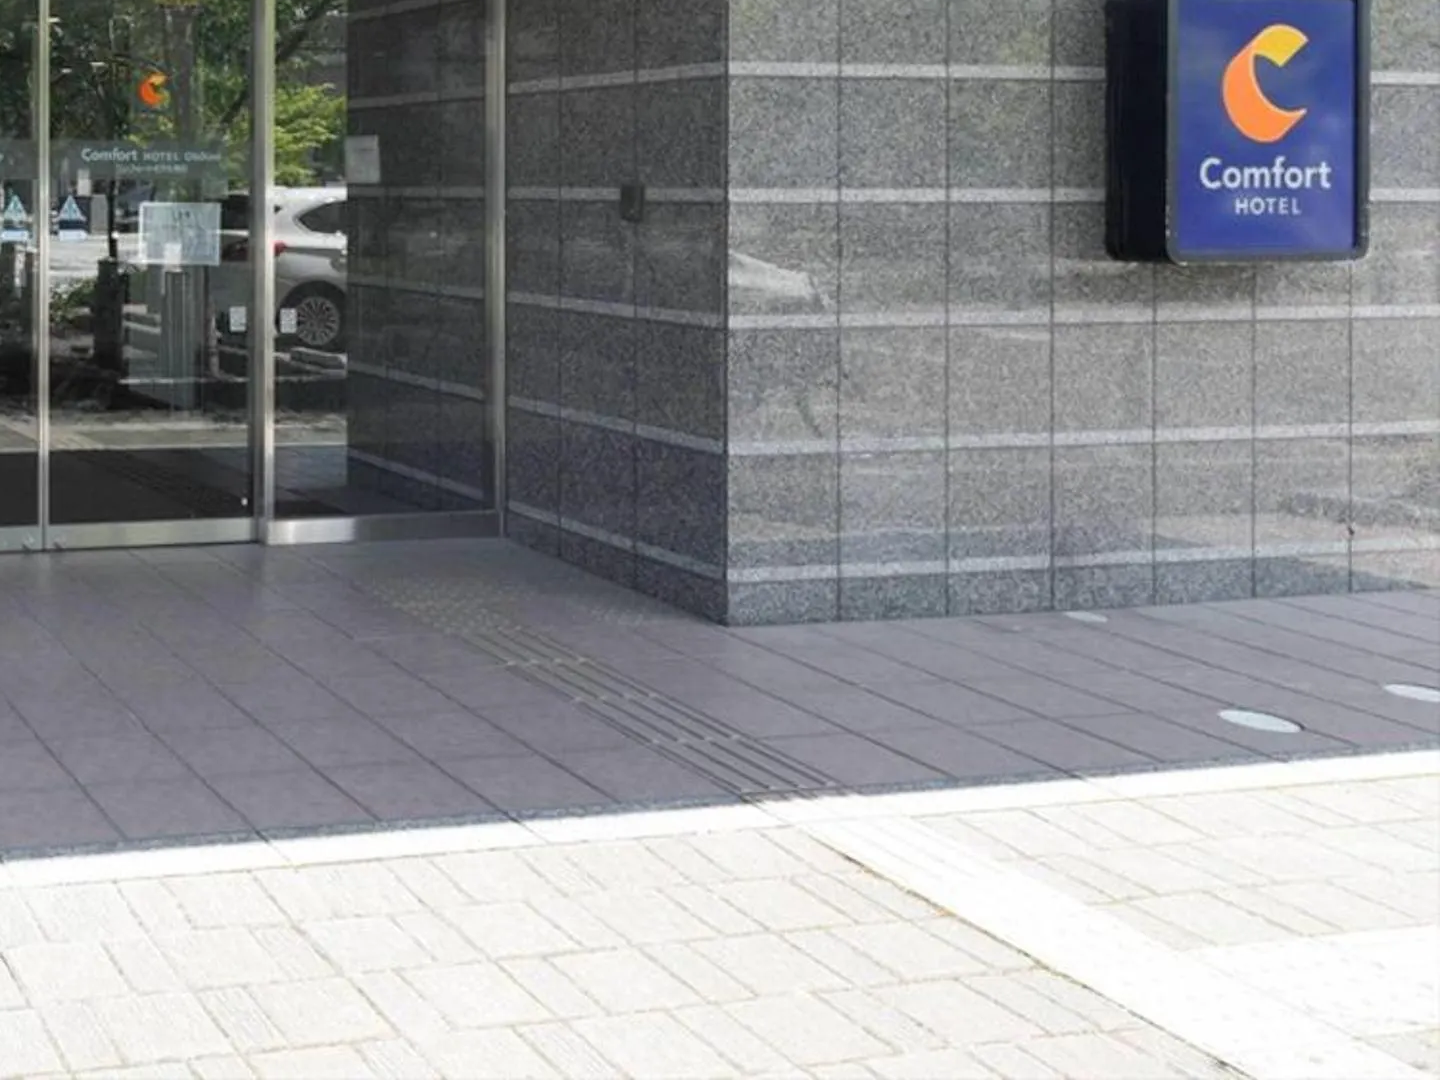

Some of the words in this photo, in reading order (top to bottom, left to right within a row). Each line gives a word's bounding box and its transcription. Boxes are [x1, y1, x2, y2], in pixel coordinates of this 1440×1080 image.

[81, 148, 137, 162] Comfort
[143, 152, 179, 161] HOTEL
[1199, 156, 1332, 189] Comfort
[1235, 198, 1301, 215] HOTEL
